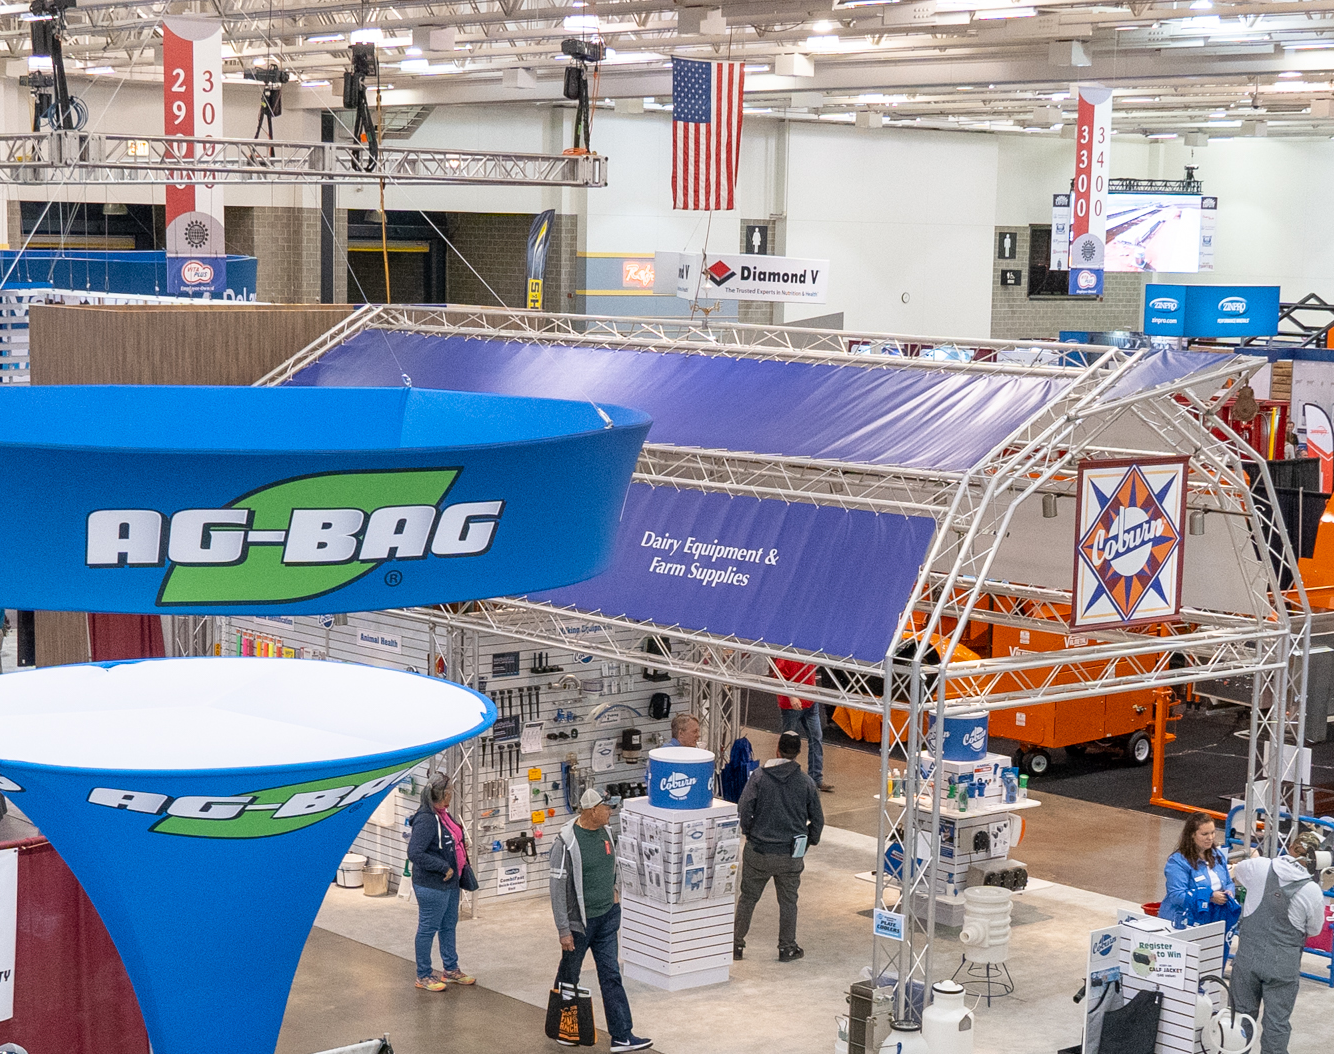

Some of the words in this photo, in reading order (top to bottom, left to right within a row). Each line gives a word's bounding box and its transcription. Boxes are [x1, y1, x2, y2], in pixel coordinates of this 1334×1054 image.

[1077, 125, 1089, 217] 3300
[1094, 127, 1105, 216] 3400
[740, 265, 807, 284] Diamond
[808, 270, 818, 284] V
[1153, 301, 1178, 310] ZINPRO
[1222, 302, 1248, 313] ZINPRO
[85, 500, 506, 569] AG-BAG
[1092, 505, 1165, 567] Coburn
[641, 530, 679, 555] Dairy
[682, 536, 762, 566] Equipment
[763, 548, 779, 565] &
[649, 556, 684, 578] Farm
[687, 563, 750, 588] Supplies
[360, 632, 380, 645] Animal
[380, 636, 398, 649] Health
[659, 771, 698, 793] Coburn
[880, 919, 897, 928] PLATE
[1092, 934, 1117, 955] Coburn
[1139, 942, 1173, 951] Register
[1167, 951, 1182, 959] Win
